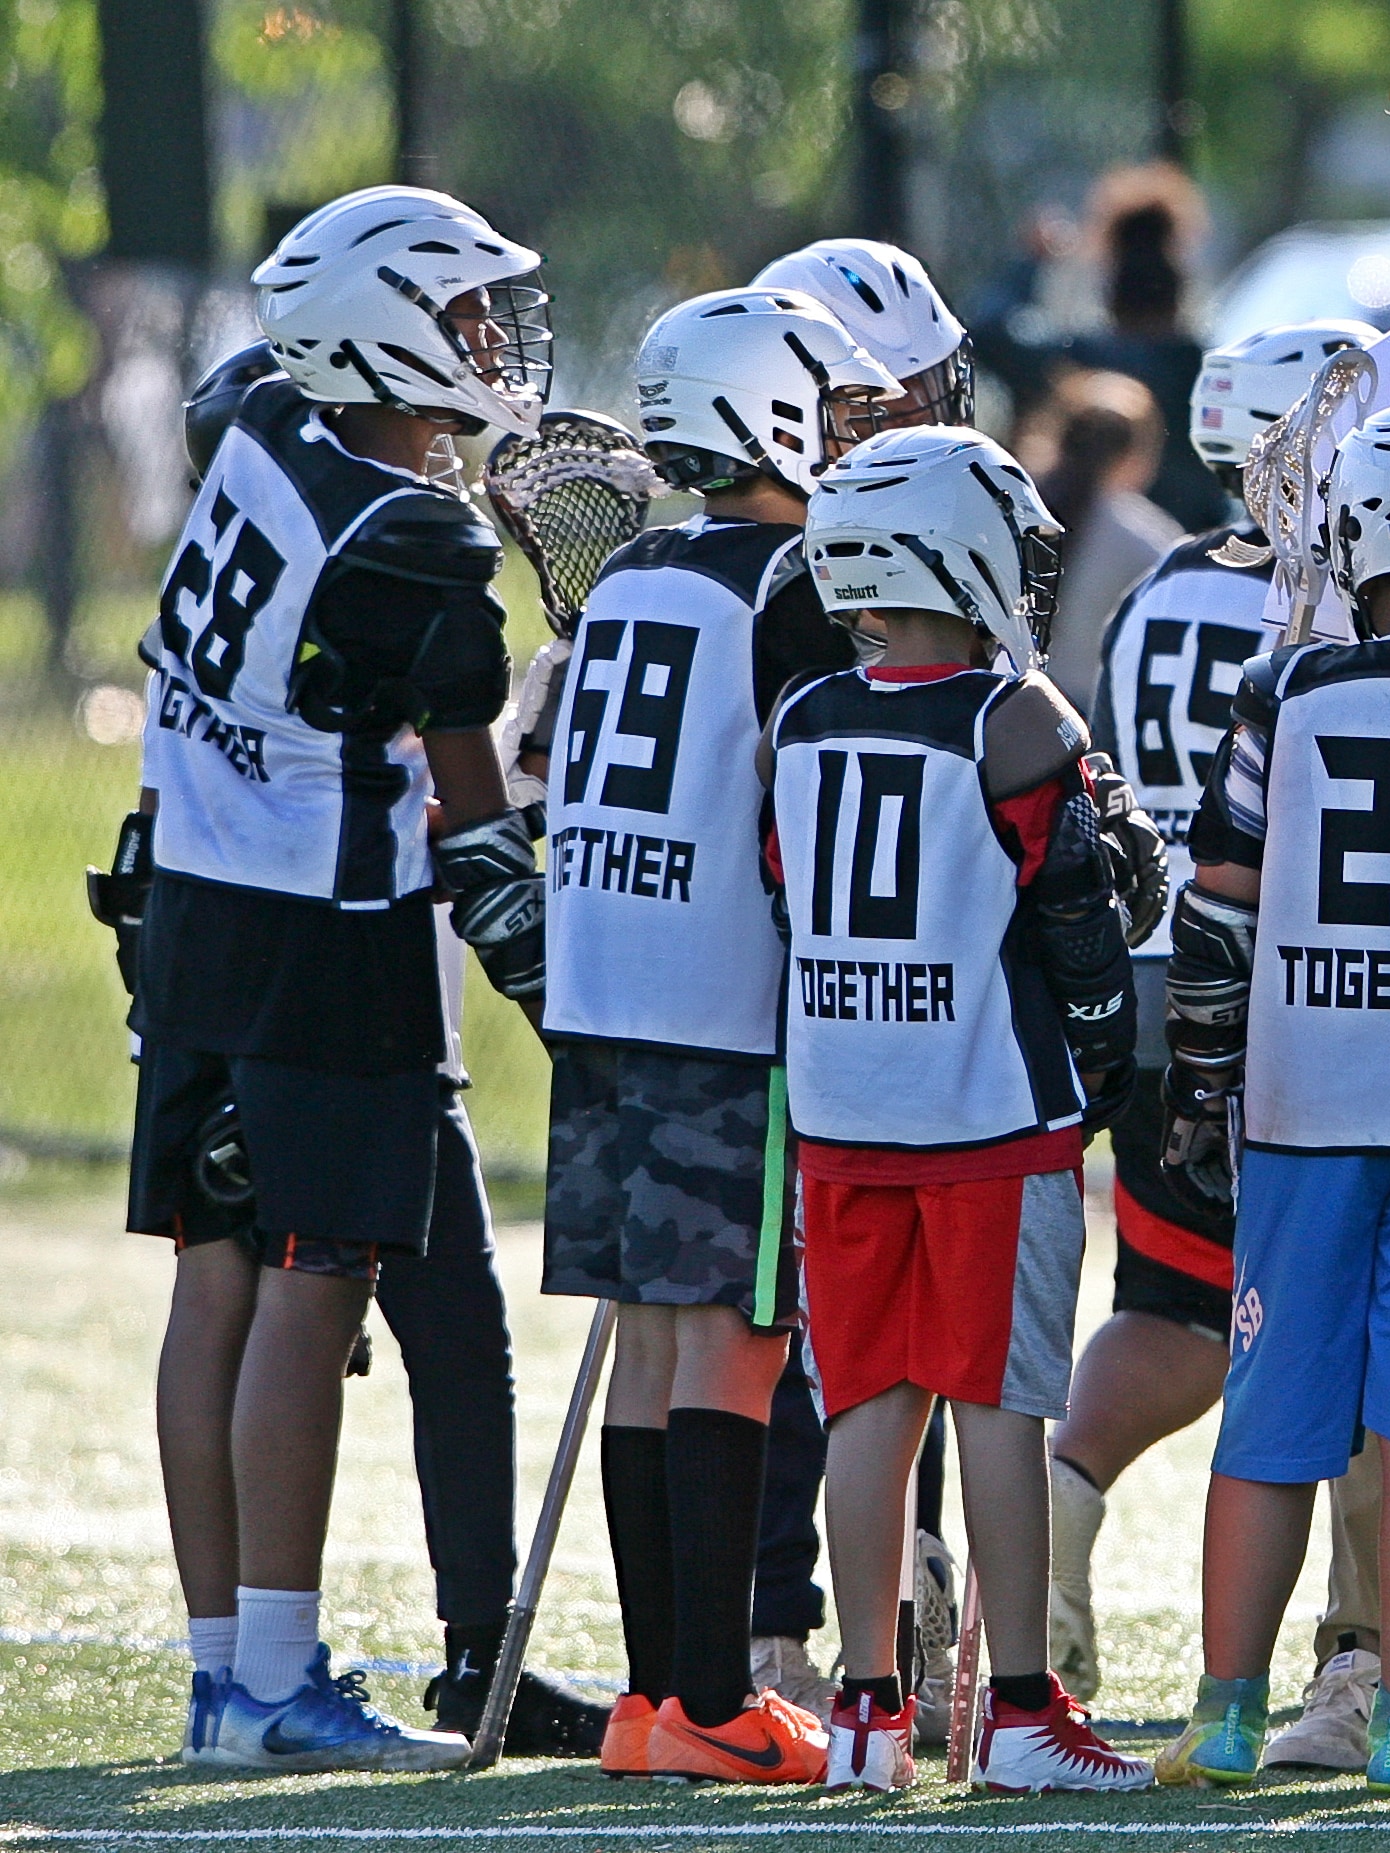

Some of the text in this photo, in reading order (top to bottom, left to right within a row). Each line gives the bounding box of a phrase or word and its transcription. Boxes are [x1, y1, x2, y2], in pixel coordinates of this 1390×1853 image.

[834, 584, 879, 600] schutt
[563, 620, 700, 815] 69
[1134, 619, 1263, 786] 65
[1106, 784, 1139, 817] ST
[811, 749, 928, 940] 10
[1066, 990, 1124, 1021] STX
[1212, 1003, 1249, 1024] ST
